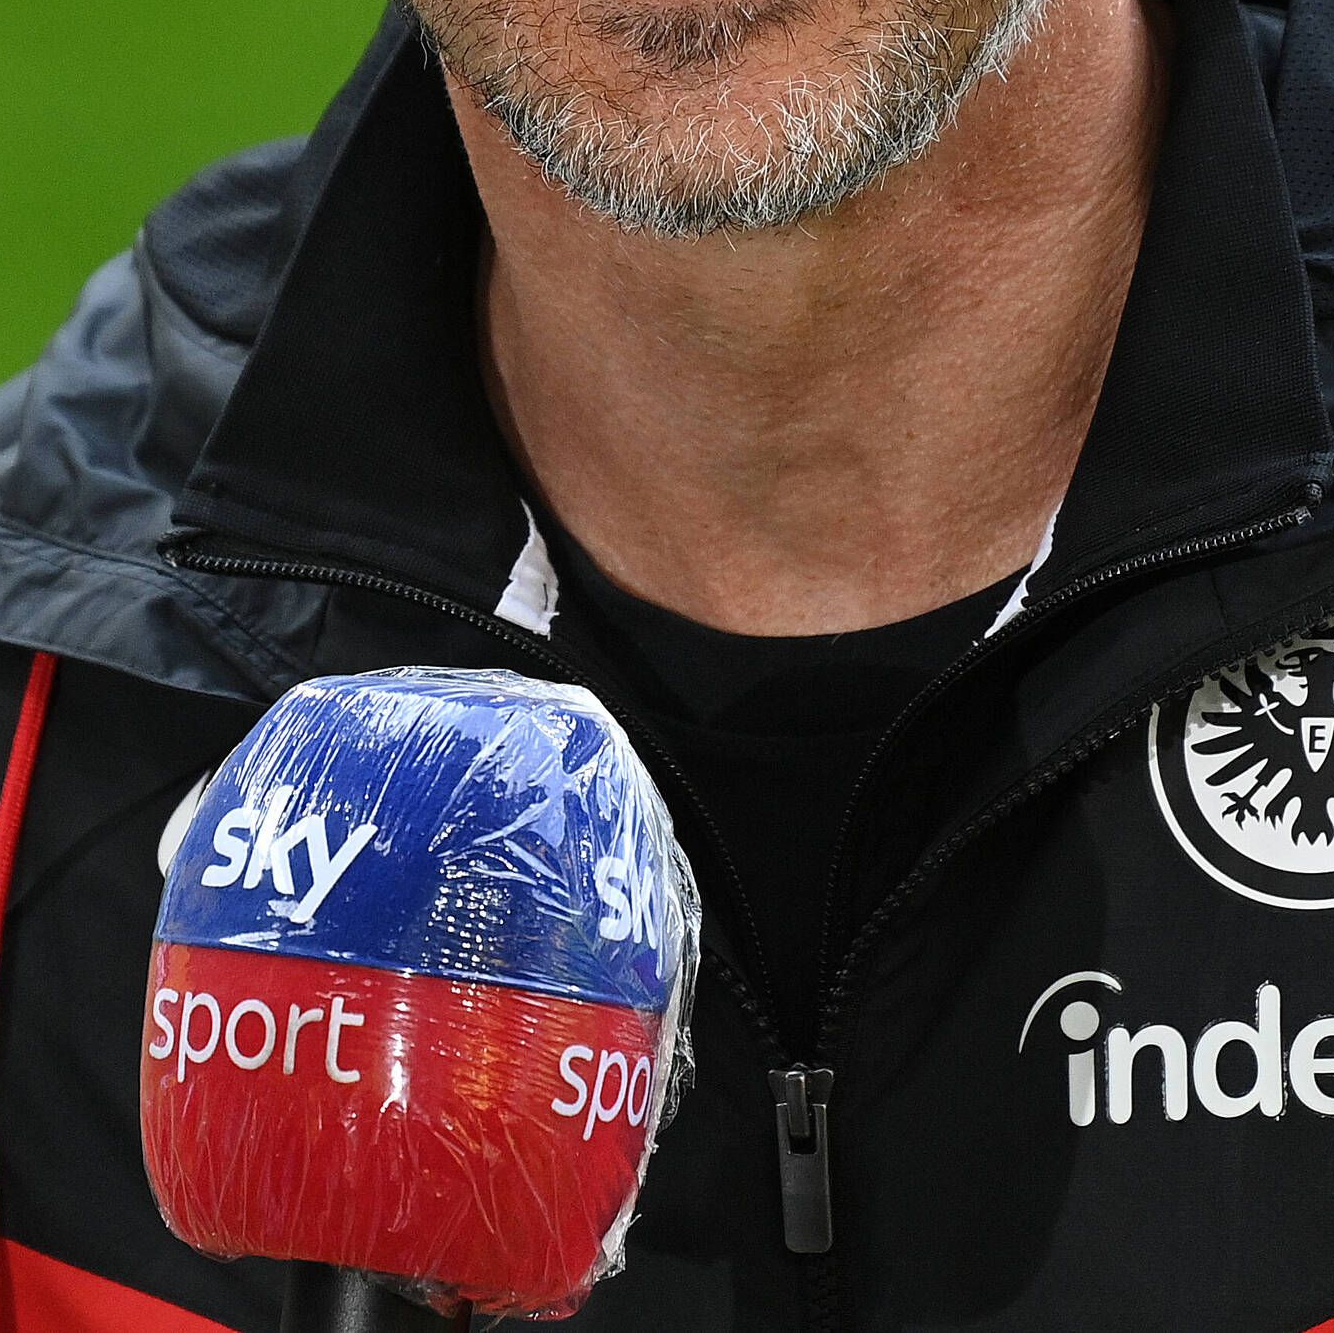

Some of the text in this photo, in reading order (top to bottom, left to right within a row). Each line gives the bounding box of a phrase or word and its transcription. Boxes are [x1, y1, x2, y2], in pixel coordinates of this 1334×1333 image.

[1308, 725, 1327, 753] E
[201, 785, 378, 924] sky
[148, 988, 365, 1084] sport
[551, 1044, 655, 1142] spo
